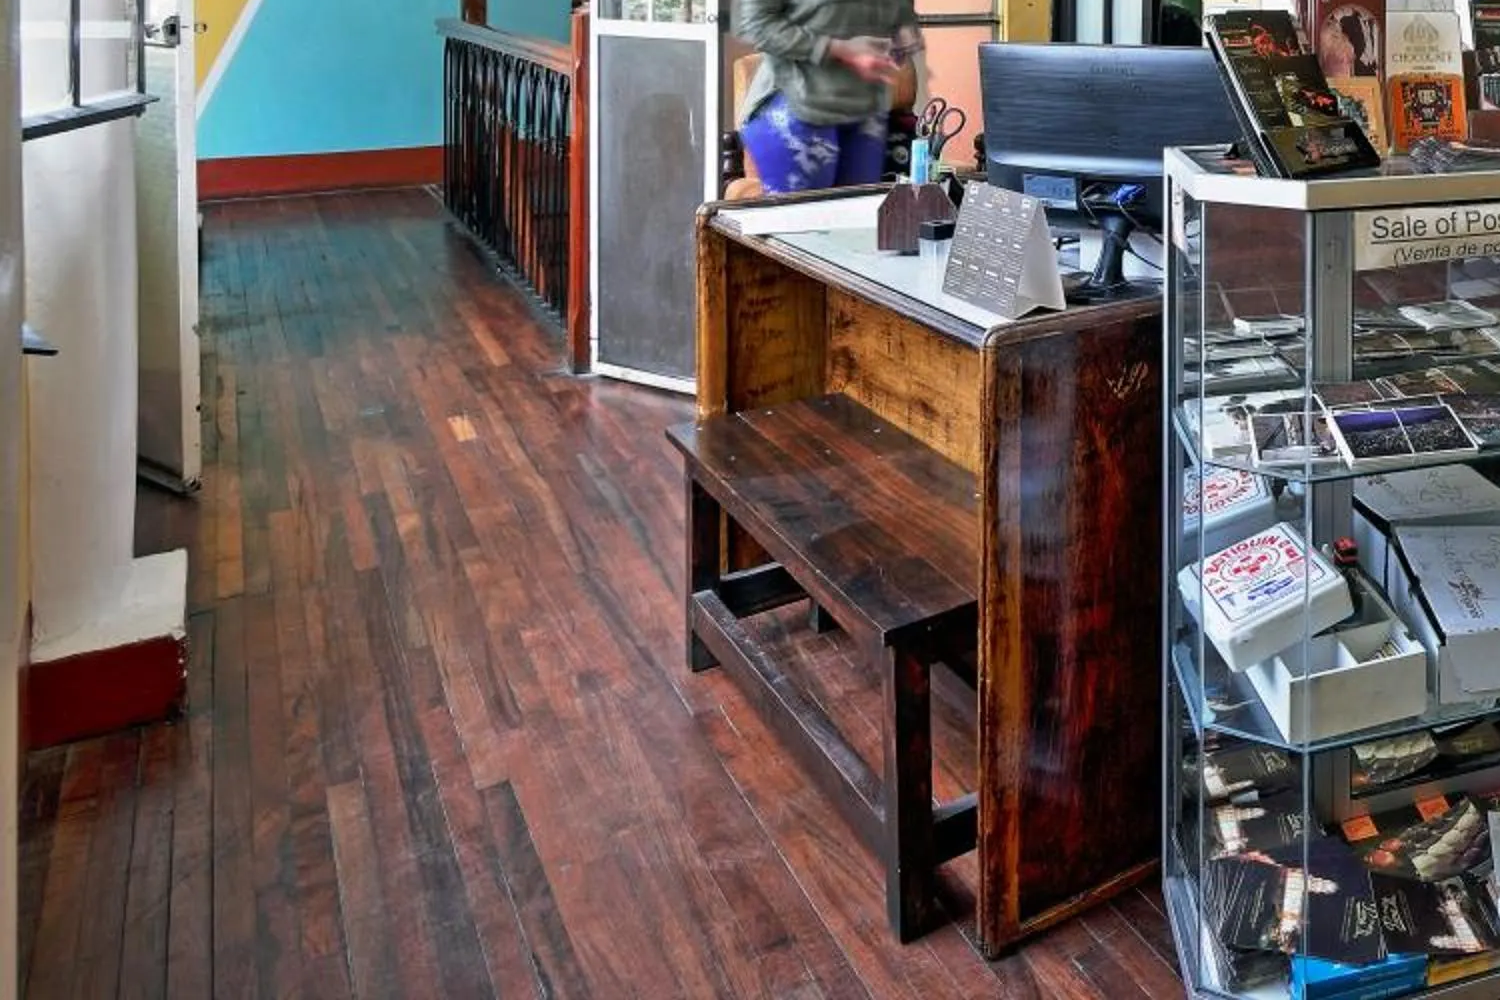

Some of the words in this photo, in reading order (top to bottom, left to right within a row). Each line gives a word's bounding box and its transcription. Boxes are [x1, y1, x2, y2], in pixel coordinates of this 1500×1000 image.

[1371, 215, 1427, 239] Sale
[1435, 211, 1459, 234] of
[1393, 246, 1451, 267] (Venta
[1456, 242, 1477, 256] de
